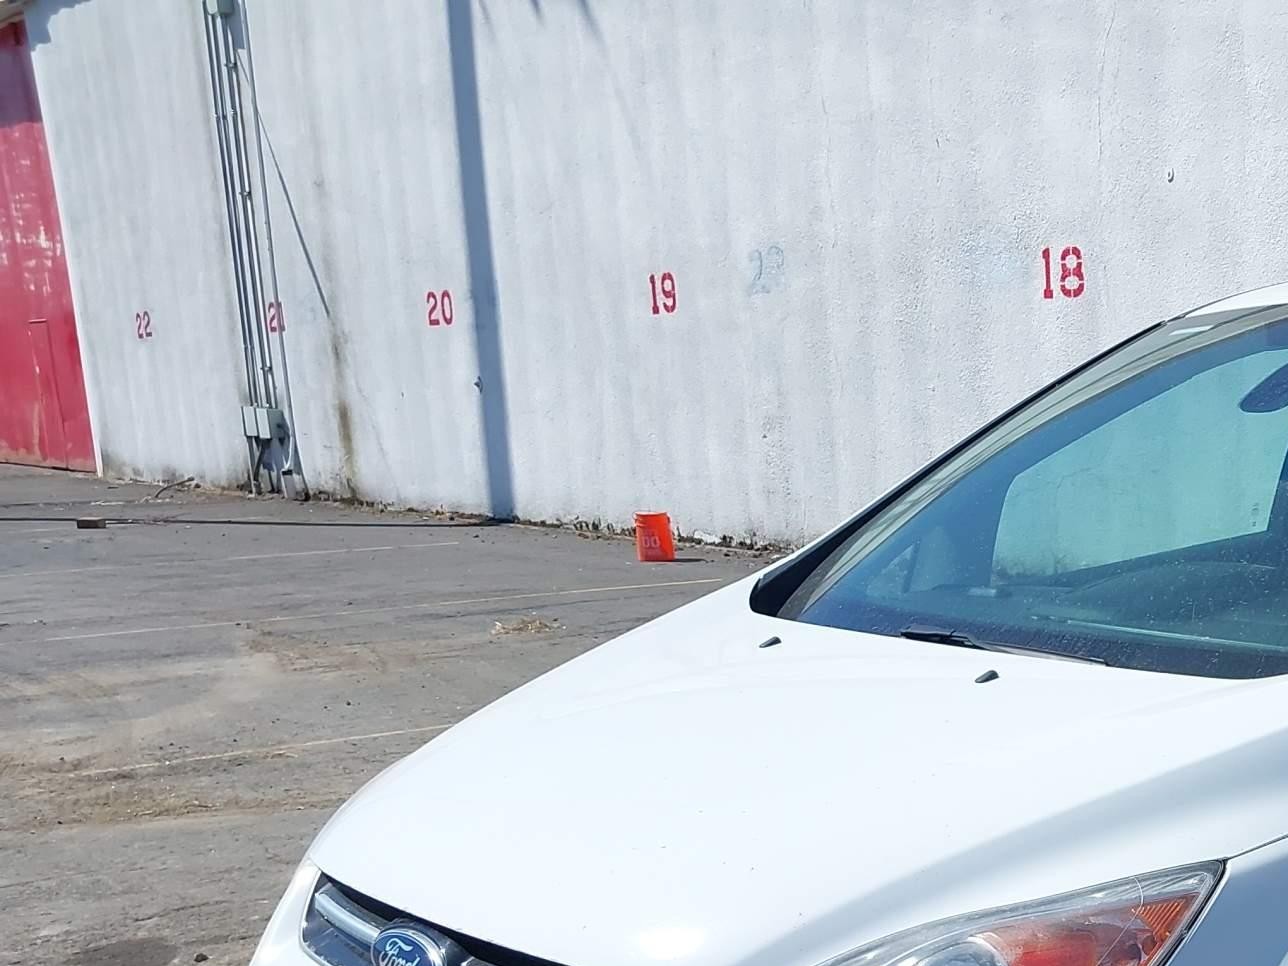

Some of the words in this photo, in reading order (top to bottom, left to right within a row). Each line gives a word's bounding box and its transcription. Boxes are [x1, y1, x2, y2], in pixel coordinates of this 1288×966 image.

[1041, 246, 1085, 299] 18
[426, 289, 453, 326] 20
[649, 271, 676, 315] 19
[135, 311, 153, 339] 22
[267, 301, 286, 333] 21
